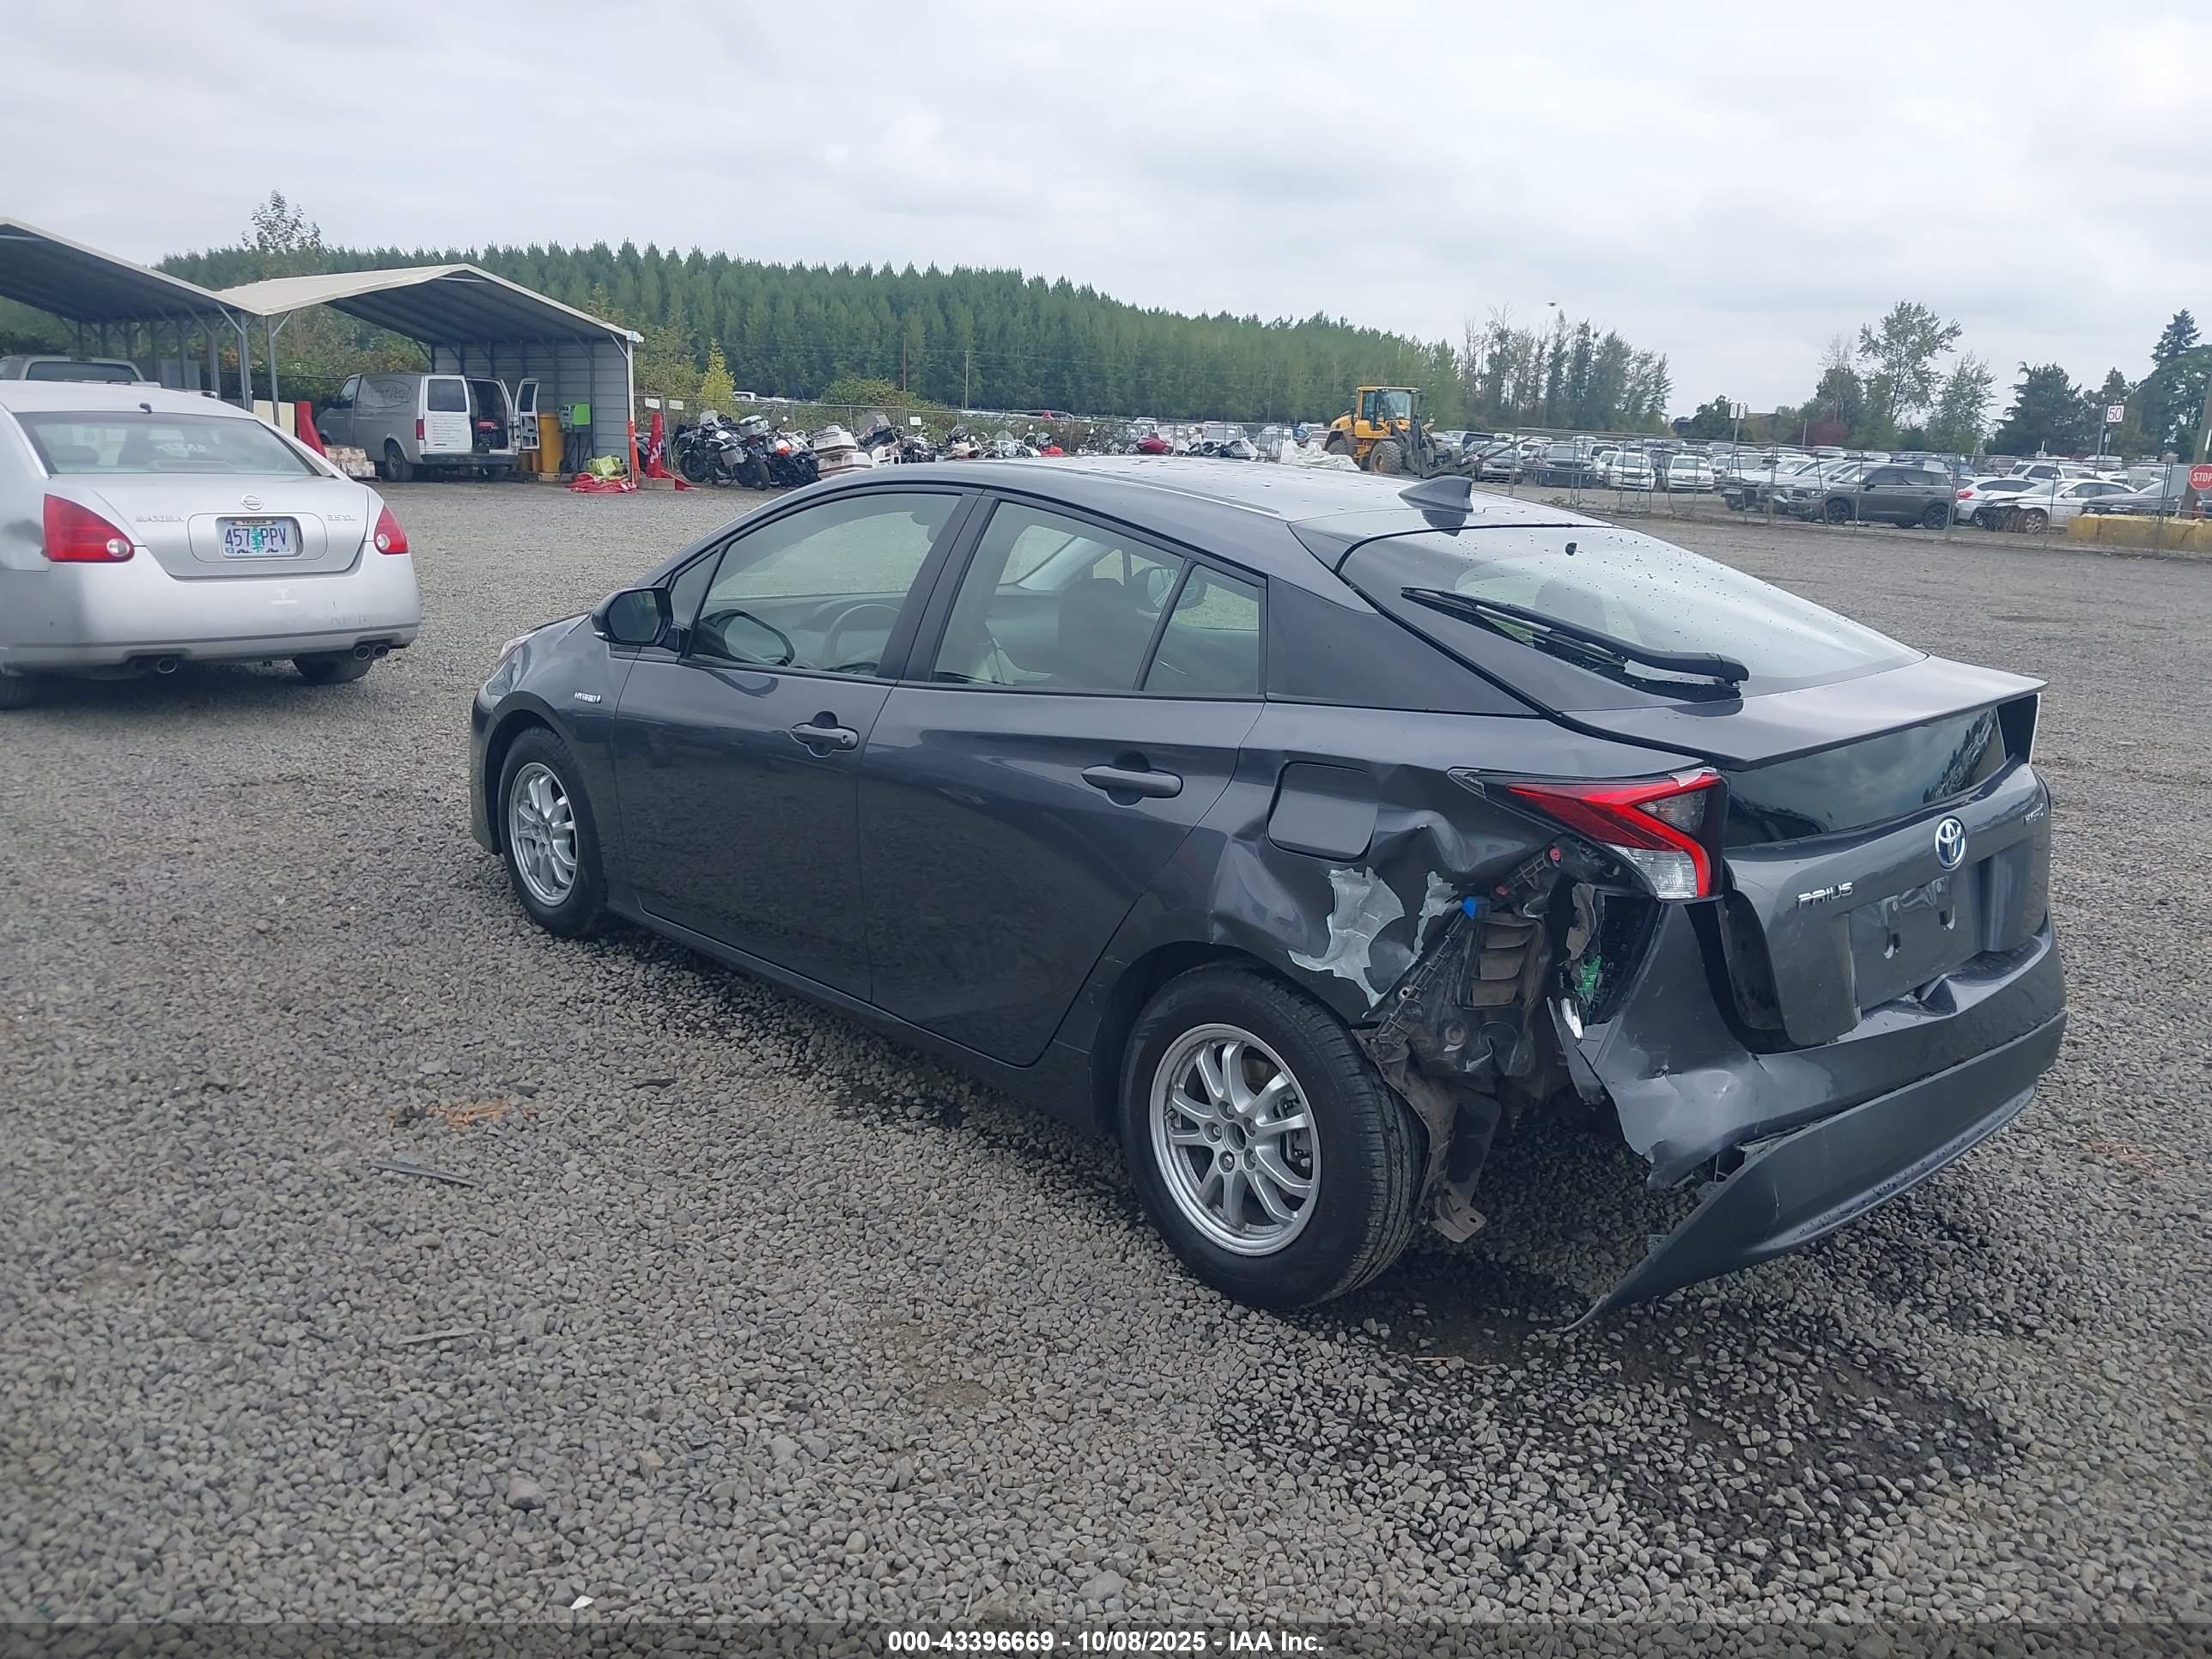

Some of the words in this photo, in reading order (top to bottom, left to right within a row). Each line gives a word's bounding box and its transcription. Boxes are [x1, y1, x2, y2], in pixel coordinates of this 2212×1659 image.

[2108, 407, 2122, 421] 50
[225, 528, 251, 547] 457
[260, 527, 286, 546] PPV
[1797, 882, 1853, 909] PRIUS
